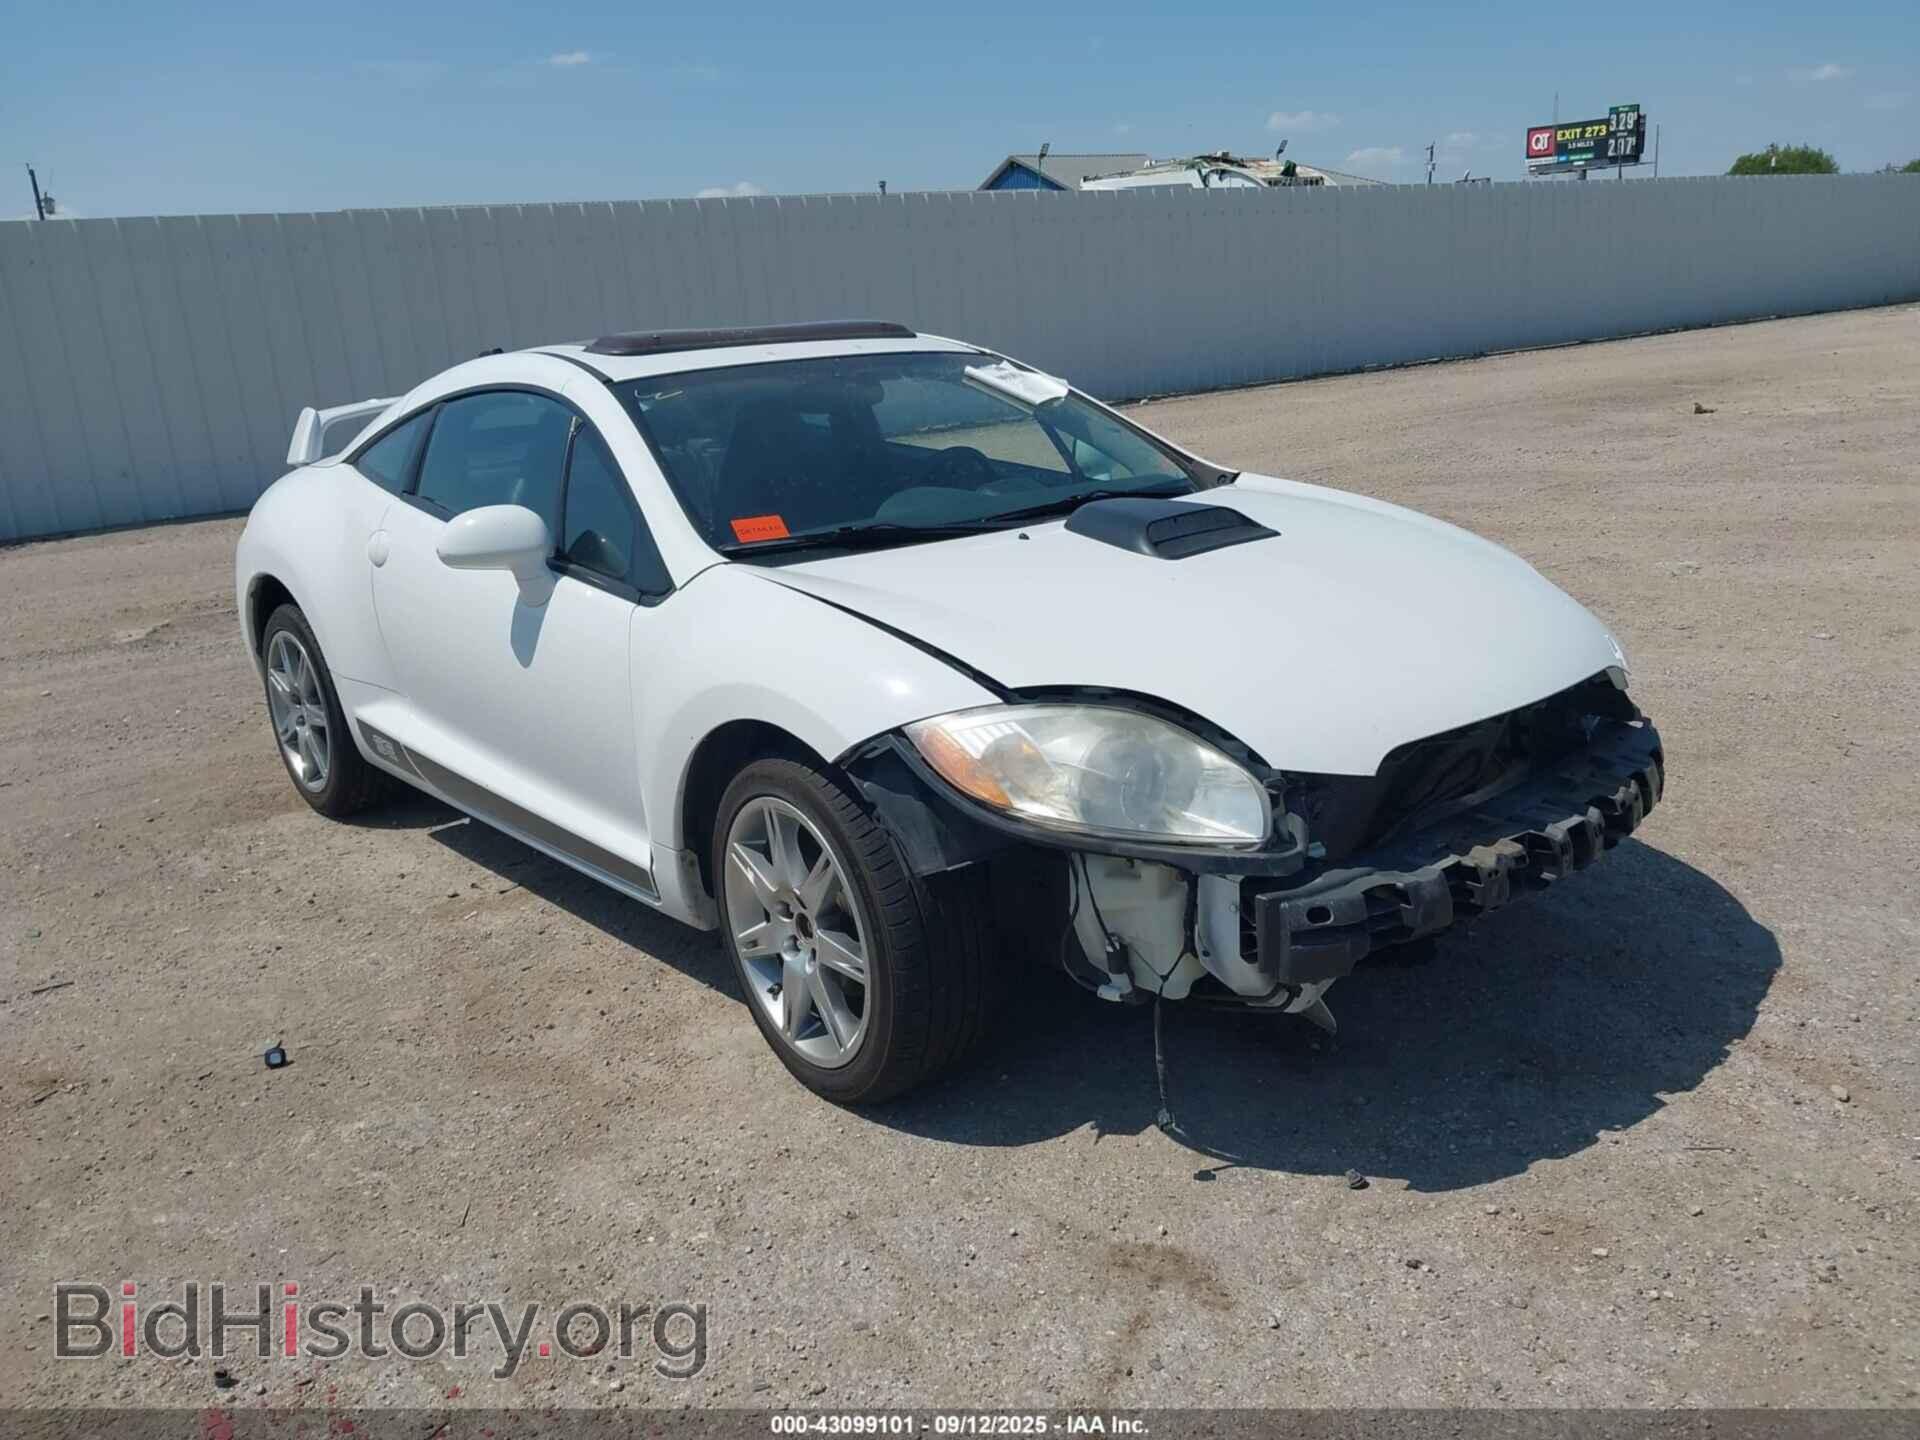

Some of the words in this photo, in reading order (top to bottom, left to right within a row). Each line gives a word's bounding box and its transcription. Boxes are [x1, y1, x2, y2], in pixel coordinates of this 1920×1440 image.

[1556, 128, 1582, 141] EXIT
[1585, 125, 1607, 138] 273
[1532, 133, 1550, 151] QT
